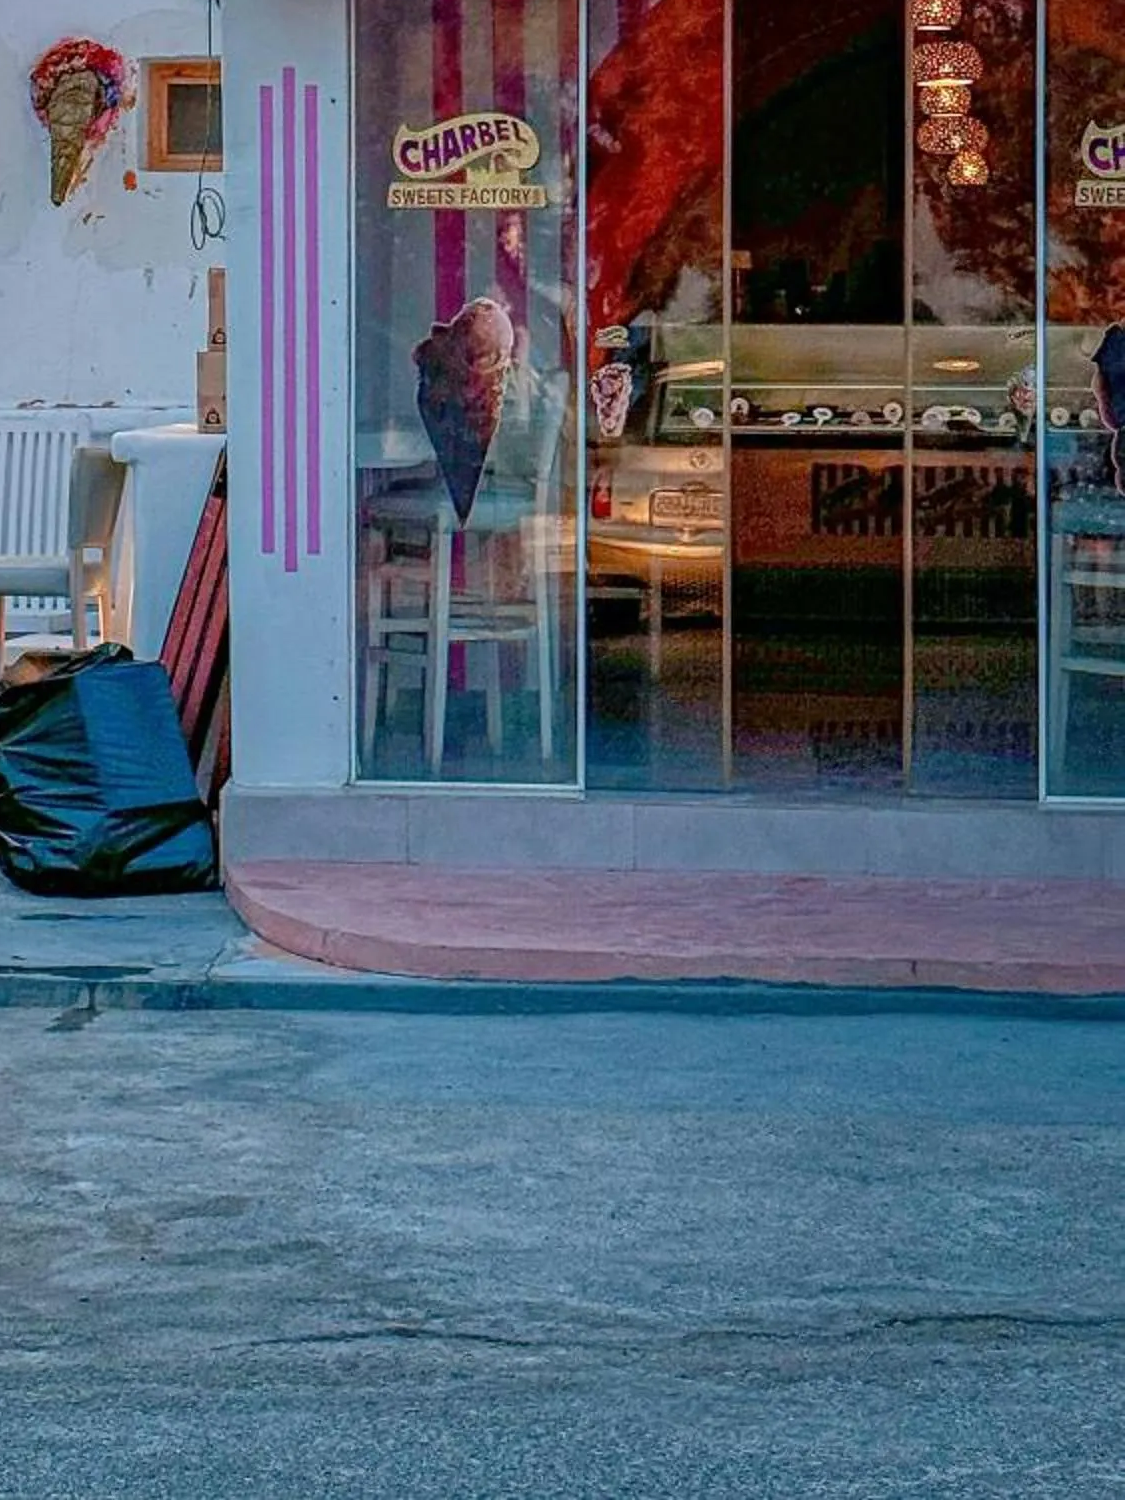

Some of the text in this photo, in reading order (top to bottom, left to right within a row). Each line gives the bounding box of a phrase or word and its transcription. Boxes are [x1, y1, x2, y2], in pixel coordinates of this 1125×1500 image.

[399, 119, 528, 173] CHARBEL
[391, 187, 456, 205] SWEETS
[460, 187, 532, 205] FACTORY
